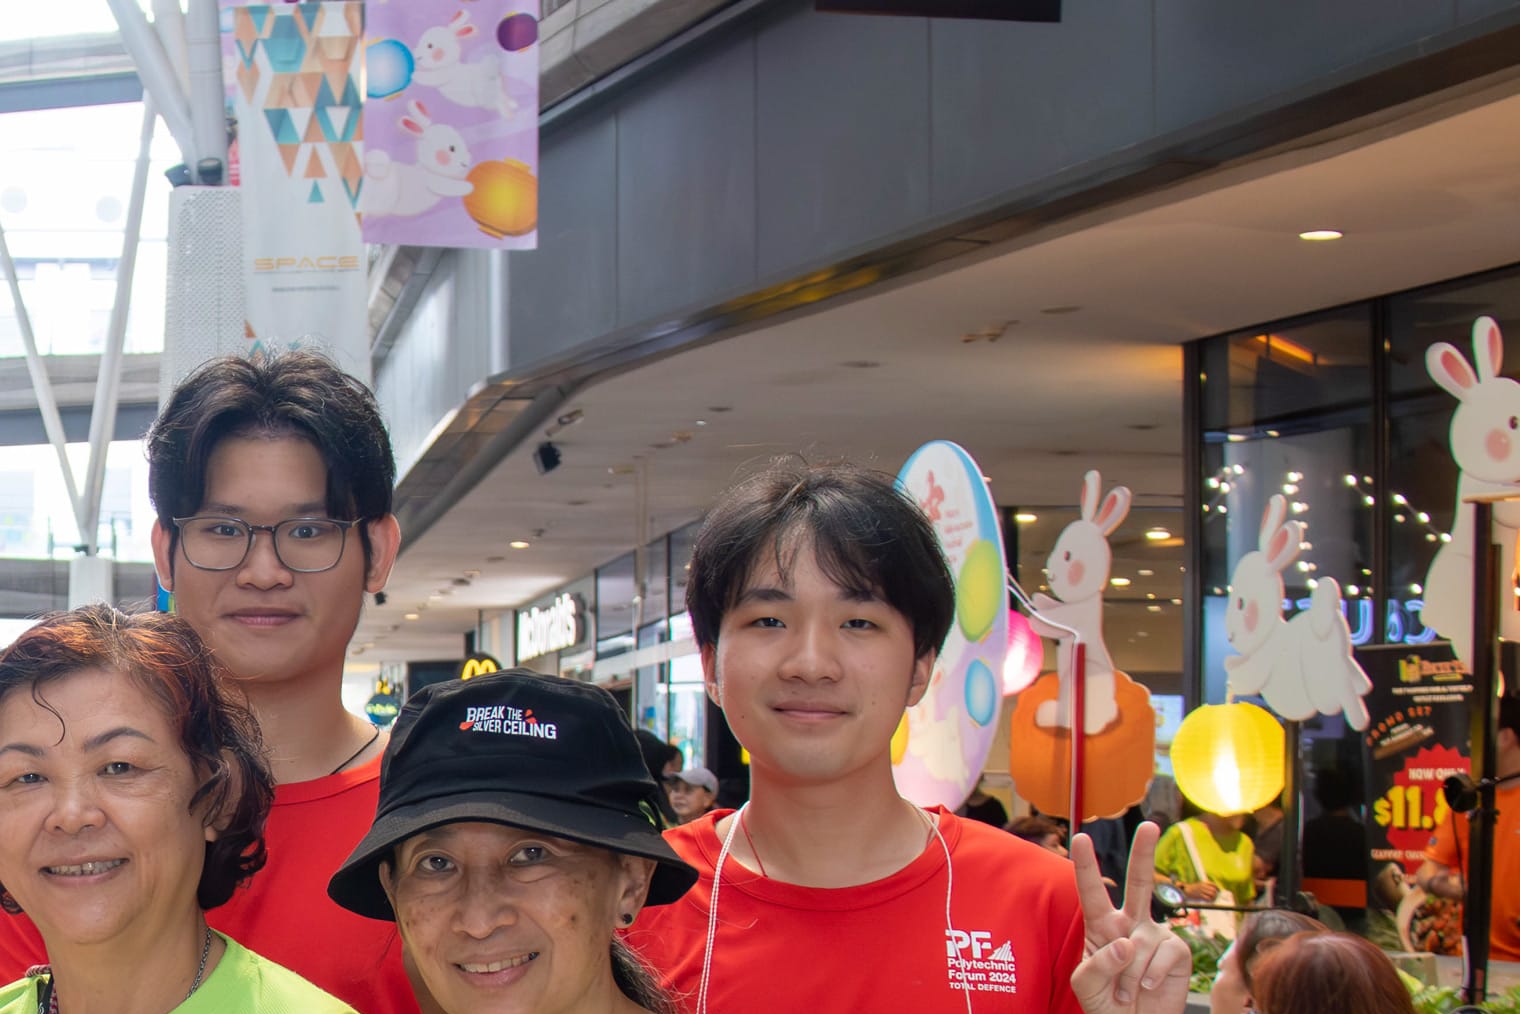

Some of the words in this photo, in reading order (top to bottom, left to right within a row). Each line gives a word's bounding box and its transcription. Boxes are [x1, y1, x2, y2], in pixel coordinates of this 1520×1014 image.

[255, 256, 360, 271] SPACE
[466, 706, 505, 722] BREAK
[506, 706, 523, 720] THE
[472, 719, 502, 733] SILVER
[503, 720, 557, 739] CEILING
[945, 929, 992, 959] PF
[947, 957, 1016, 972] Polytechnic
[948, 969, 986, 982] Forum
[988, 972, 1016, 984] 2024
[949, 982, 976, 990] TOTAL
[977, 984, 1017, 993] DEFENCE
